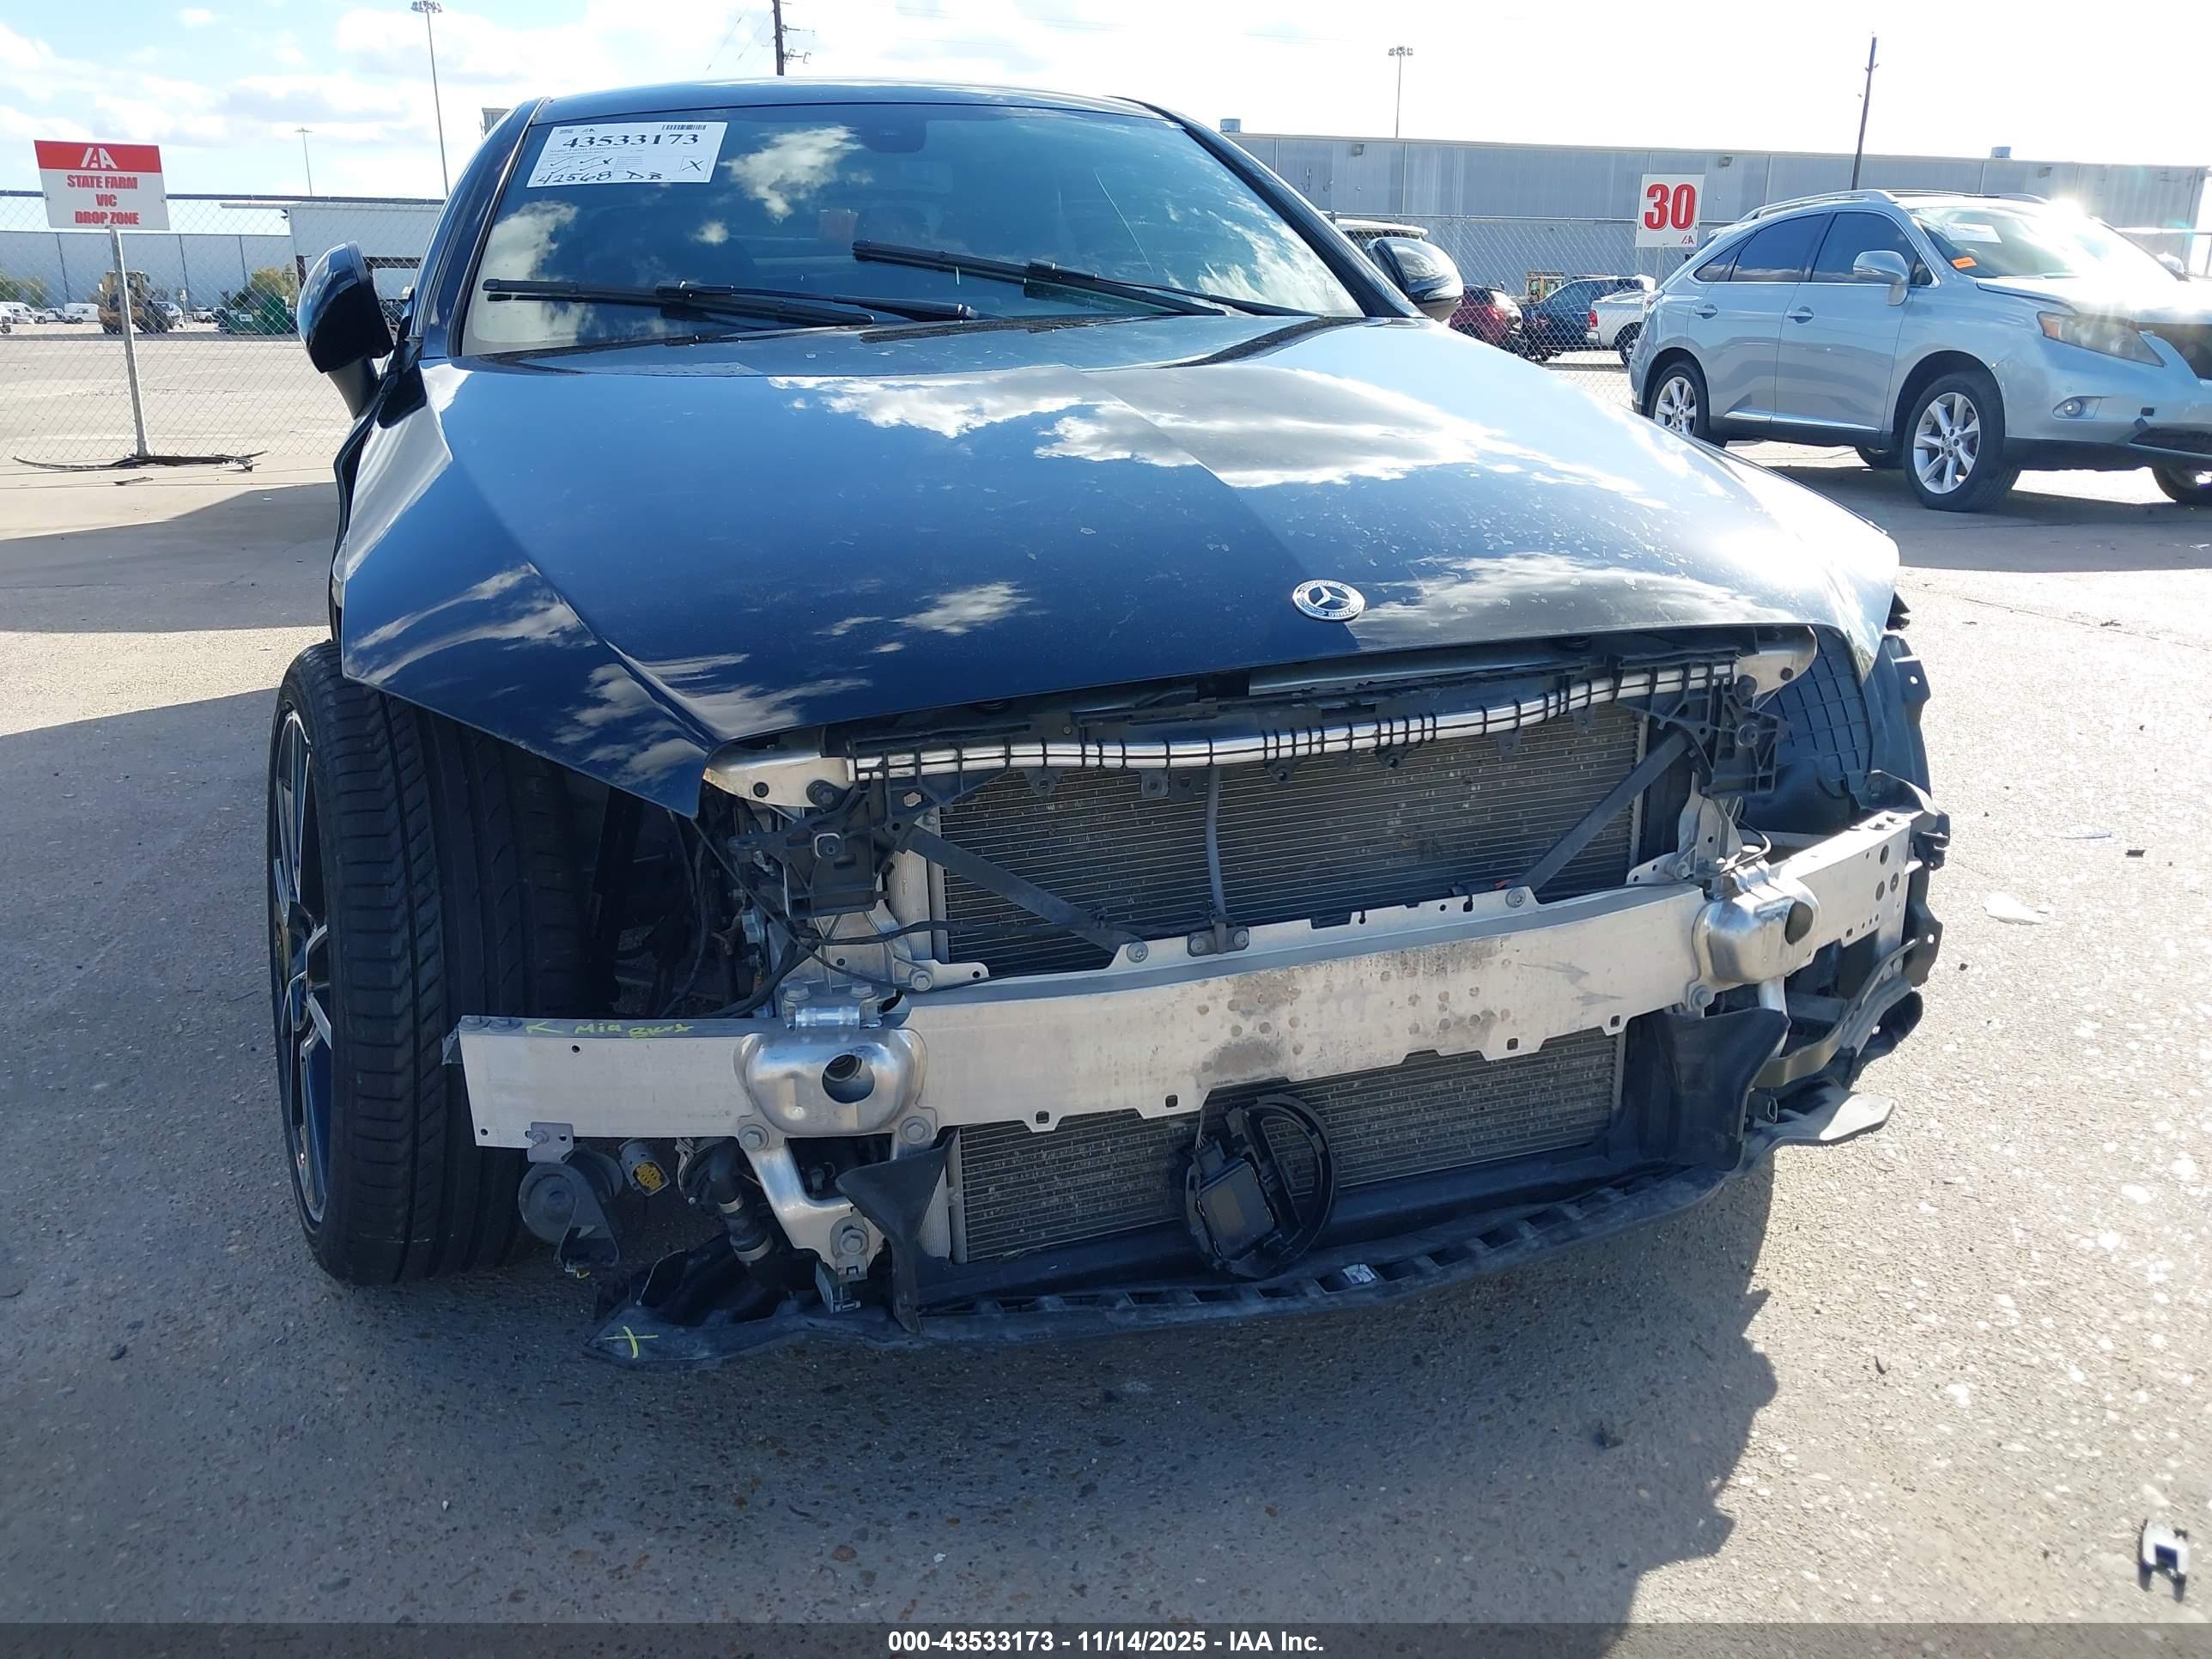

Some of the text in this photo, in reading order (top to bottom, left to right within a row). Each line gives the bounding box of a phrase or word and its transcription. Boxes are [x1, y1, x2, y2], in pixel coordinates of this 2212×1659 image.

[562, 134, 699, 148] 43533173
[67, 174, 138, 190] STATE FARM
[95, 193, 118, 207] VIC
[1644, 184, 1696, 230] 30
[75, 211, 139, 225] DROP ZONE
